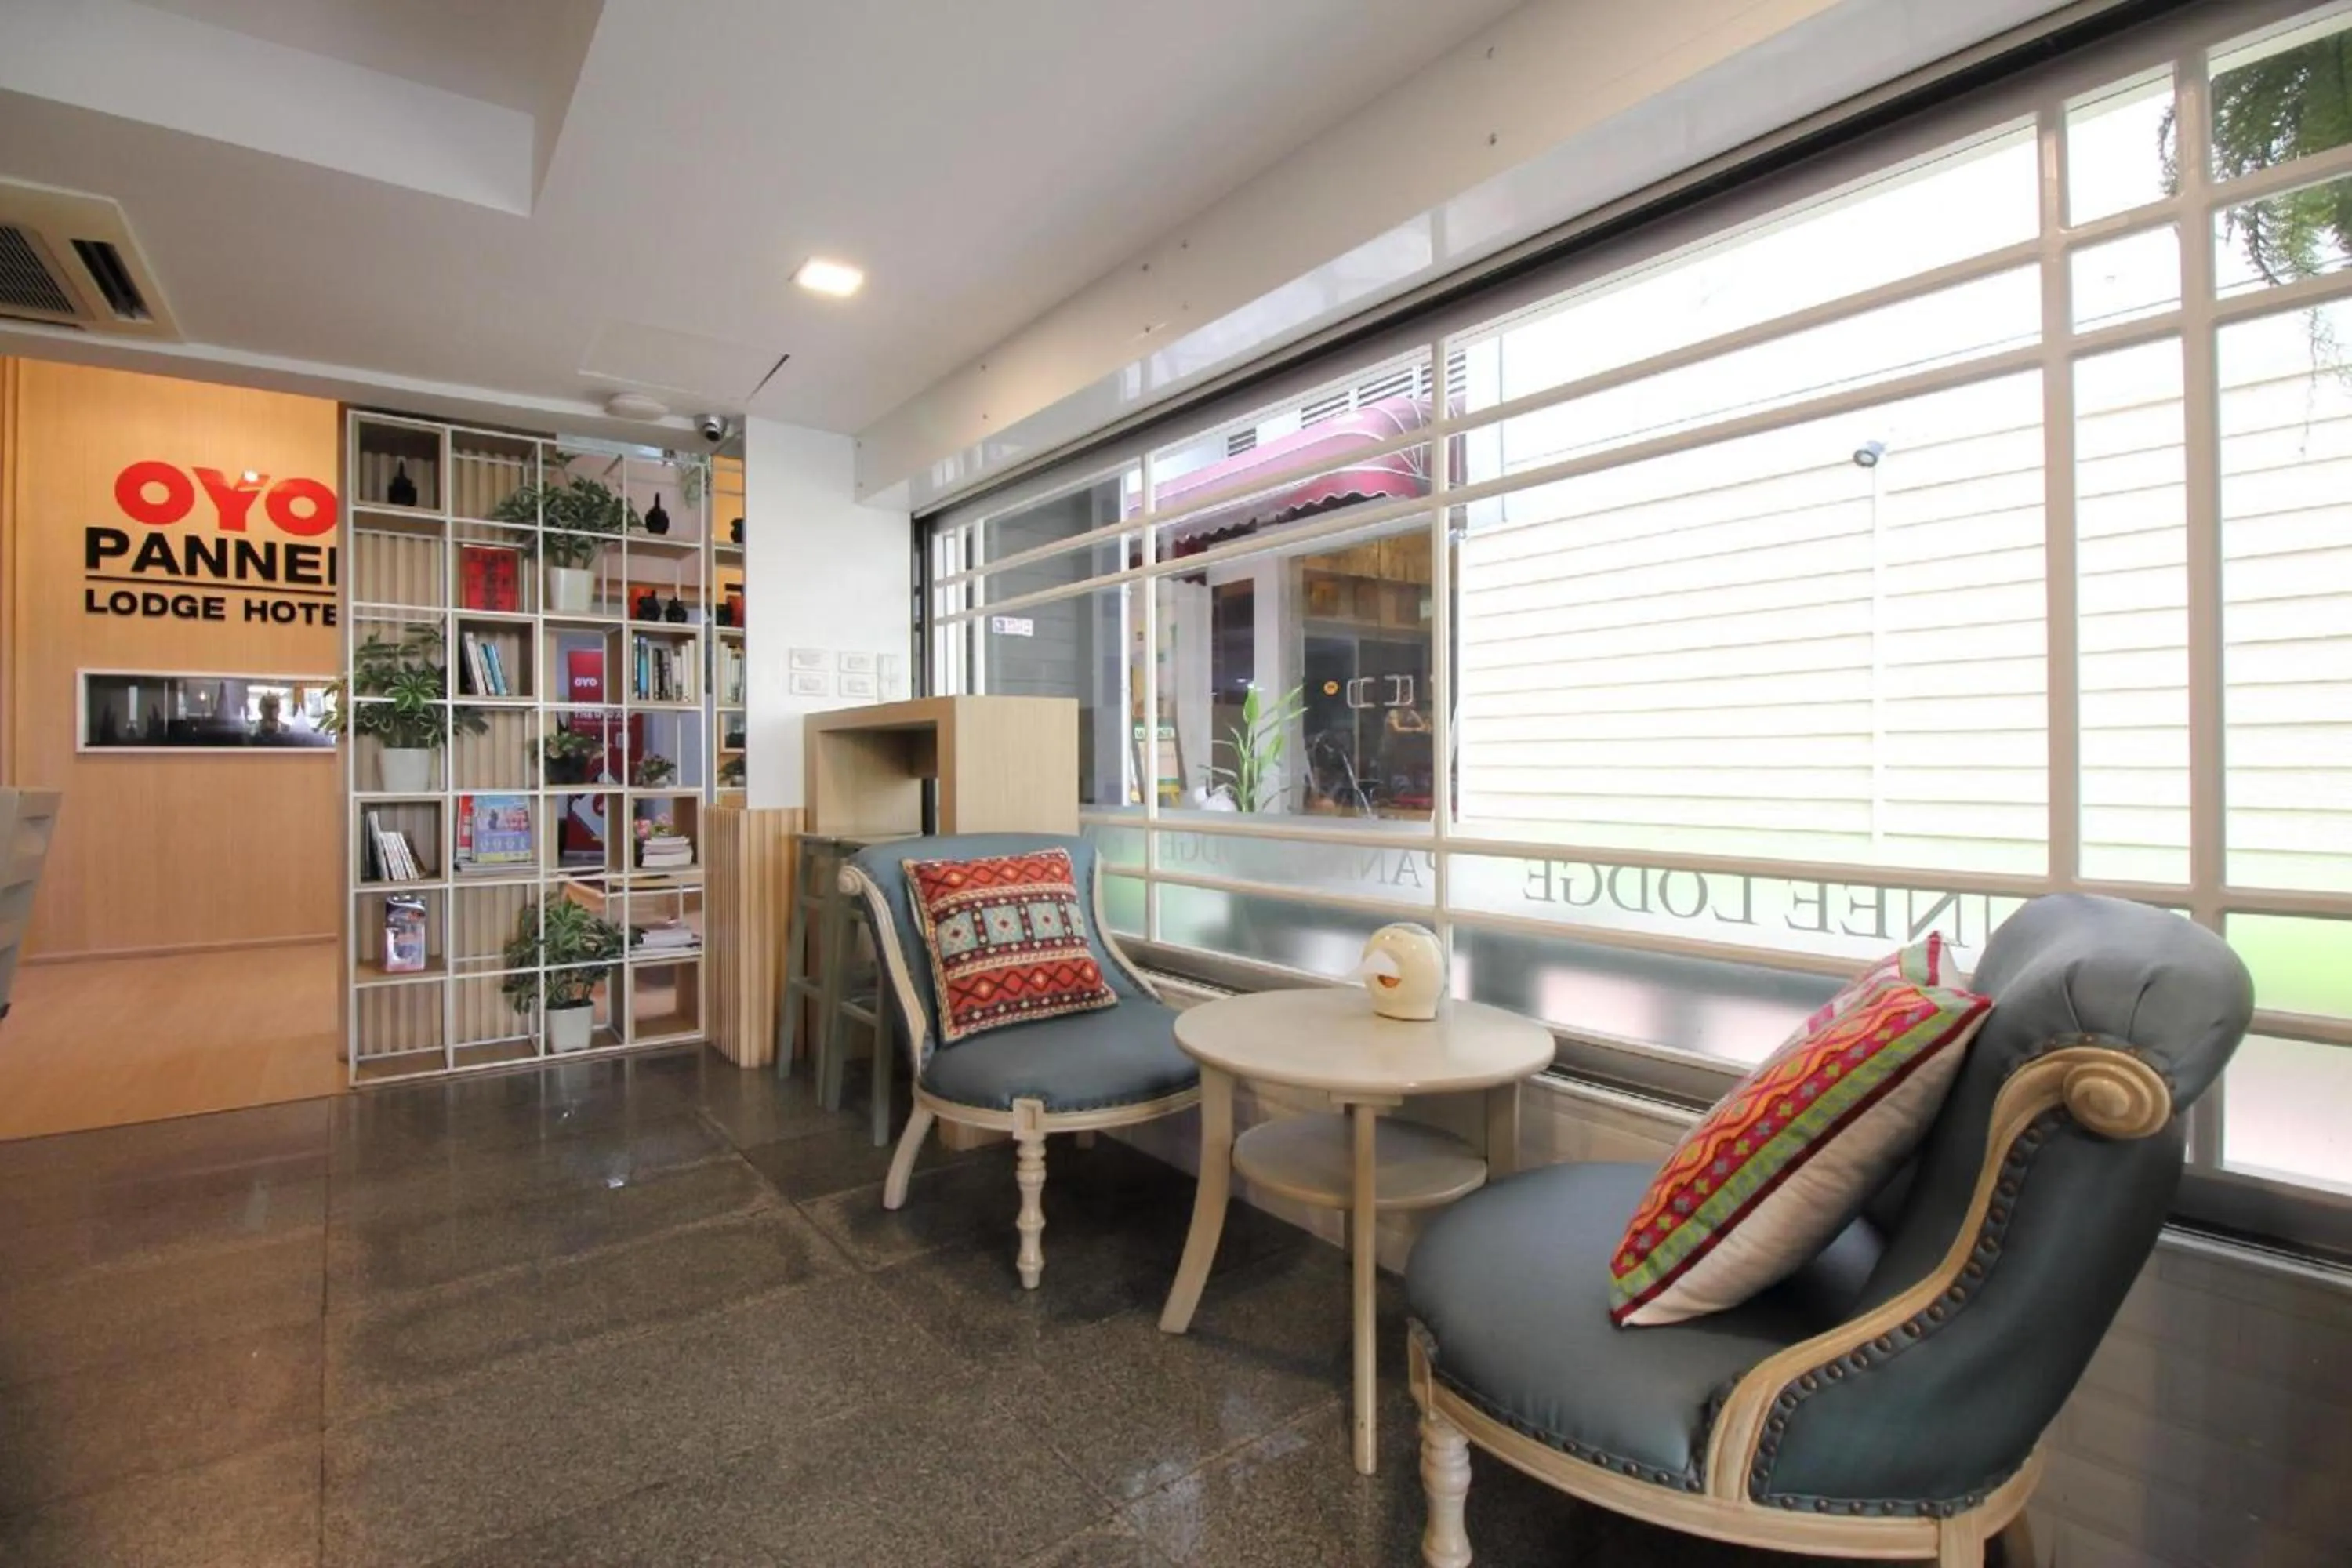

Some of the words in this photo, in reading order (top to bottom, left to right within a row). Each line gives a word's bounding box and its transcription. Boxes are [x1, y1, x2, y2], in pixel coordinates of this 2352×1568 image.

[114, 460, 337, 536] OYO
[85, 588, 226, 621] LODGE
[574, 677, 598, 688] OYO
